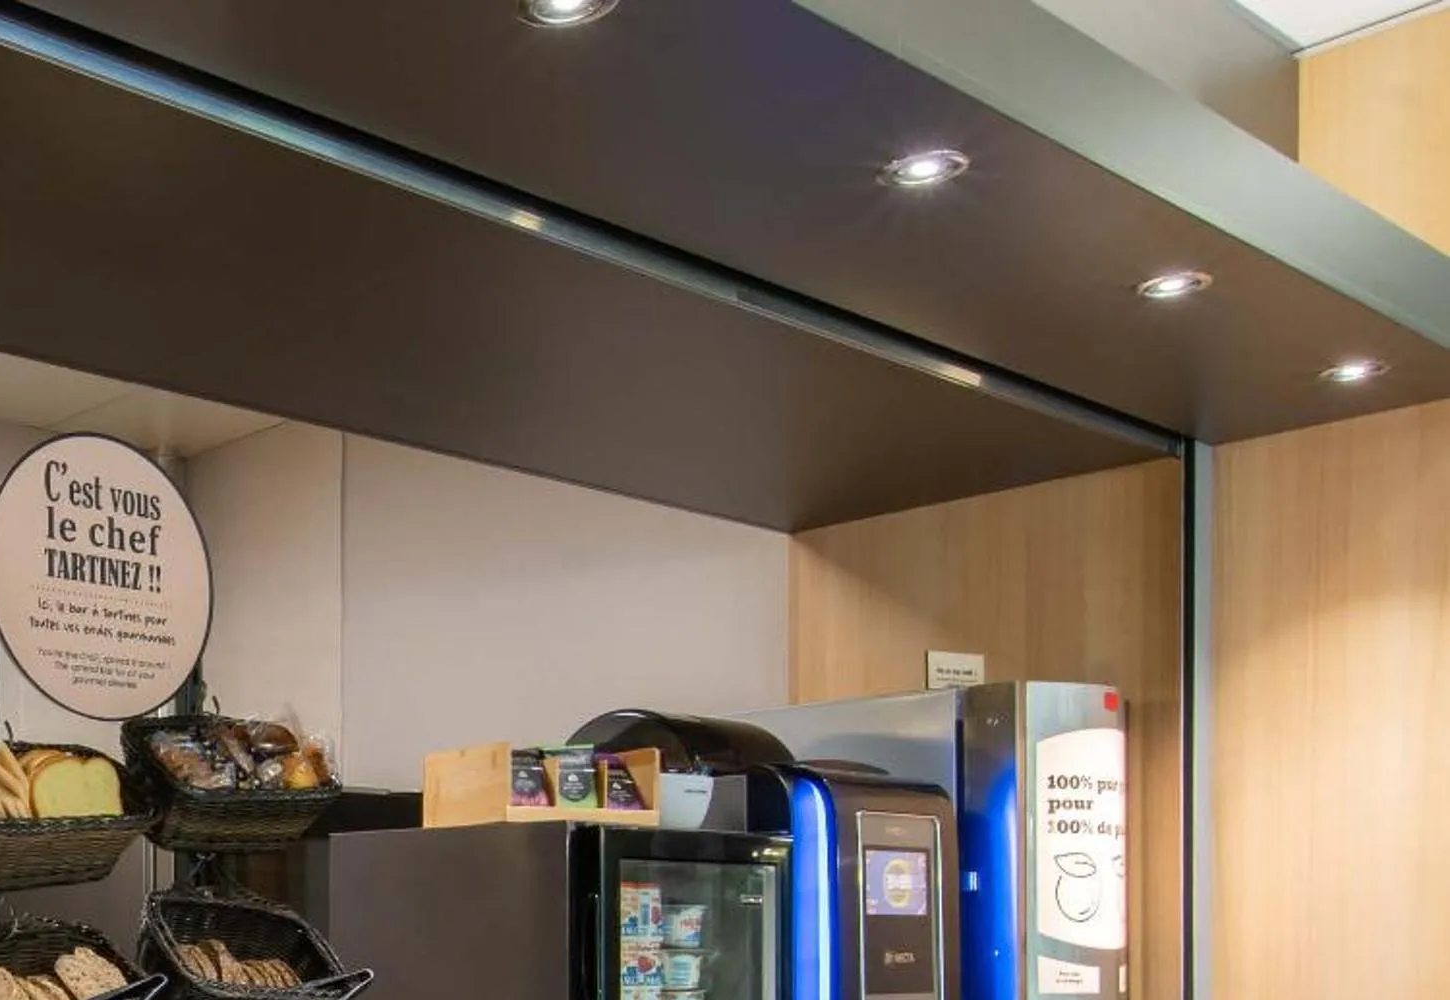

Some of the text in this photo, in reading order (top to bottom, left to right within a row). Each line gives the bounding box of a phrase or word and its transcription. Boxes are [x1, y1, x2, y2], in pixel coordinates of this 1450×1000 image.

[44, 460, 162, 521] C'est vous
[46, 506, 162, 556] le chef
[44, 548, 162, 593] TARTINEZ !!
[69, 603, 87, 614] bar
[144, 615, 168, 628] pour
[1047, 774, 1093, 789] 100%
[1047, 799, 1094, 815] pour
